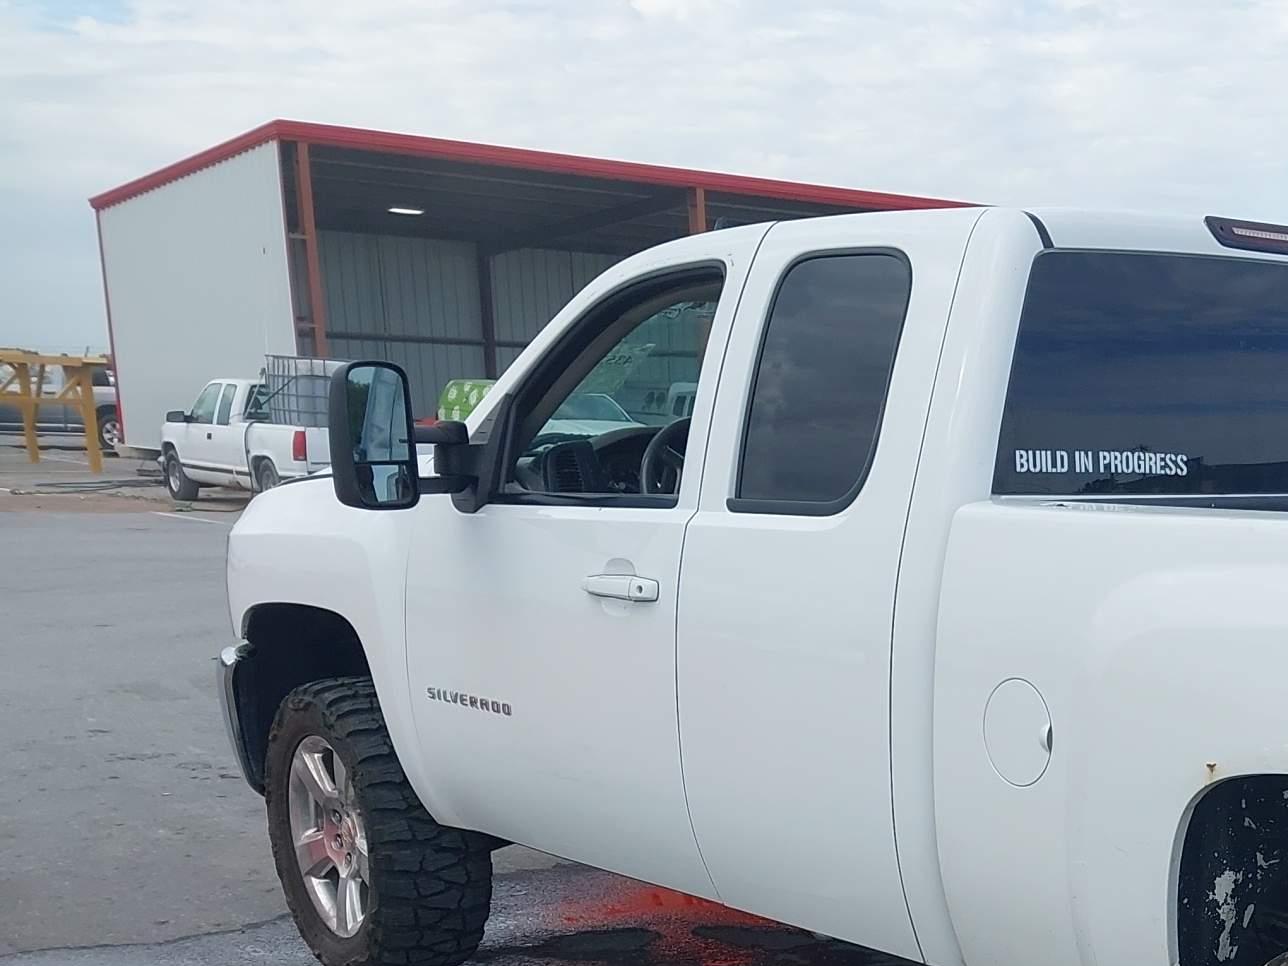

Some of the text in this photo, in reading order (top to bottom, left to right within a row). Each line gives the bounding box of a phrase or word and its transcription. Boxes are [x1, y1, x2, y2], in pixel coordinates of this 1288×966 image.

[1015, 450, 1188, 476] BUILD IN PROGRESS
[426, 687, 512, 716] SILVERADO
